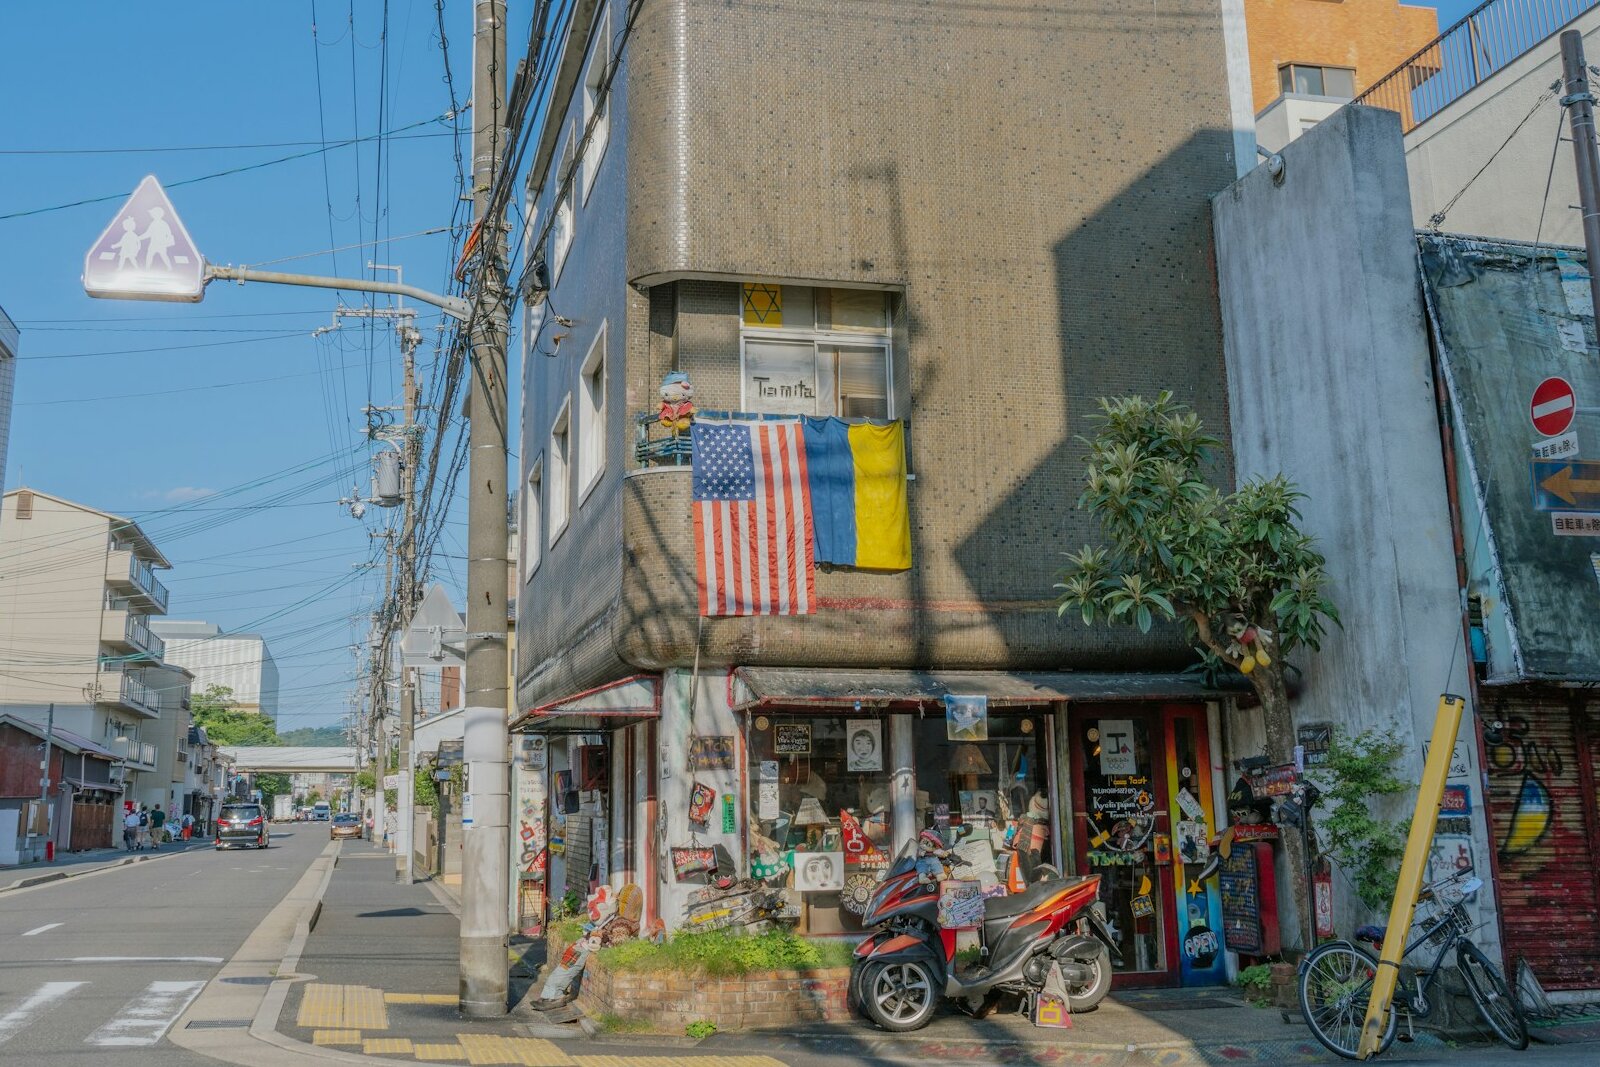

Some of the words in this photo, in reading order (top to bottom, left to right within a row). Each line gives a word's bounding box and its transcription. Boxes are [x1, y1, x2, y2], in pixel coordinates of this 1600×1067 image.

[1535, 438, 1577, 458] 自転車を除く
[1093, 796, 1116, 811] Kyoto
[1234, 827, 1279, 838] Welcome
[1184, 931, 1219, 958] OPEN
